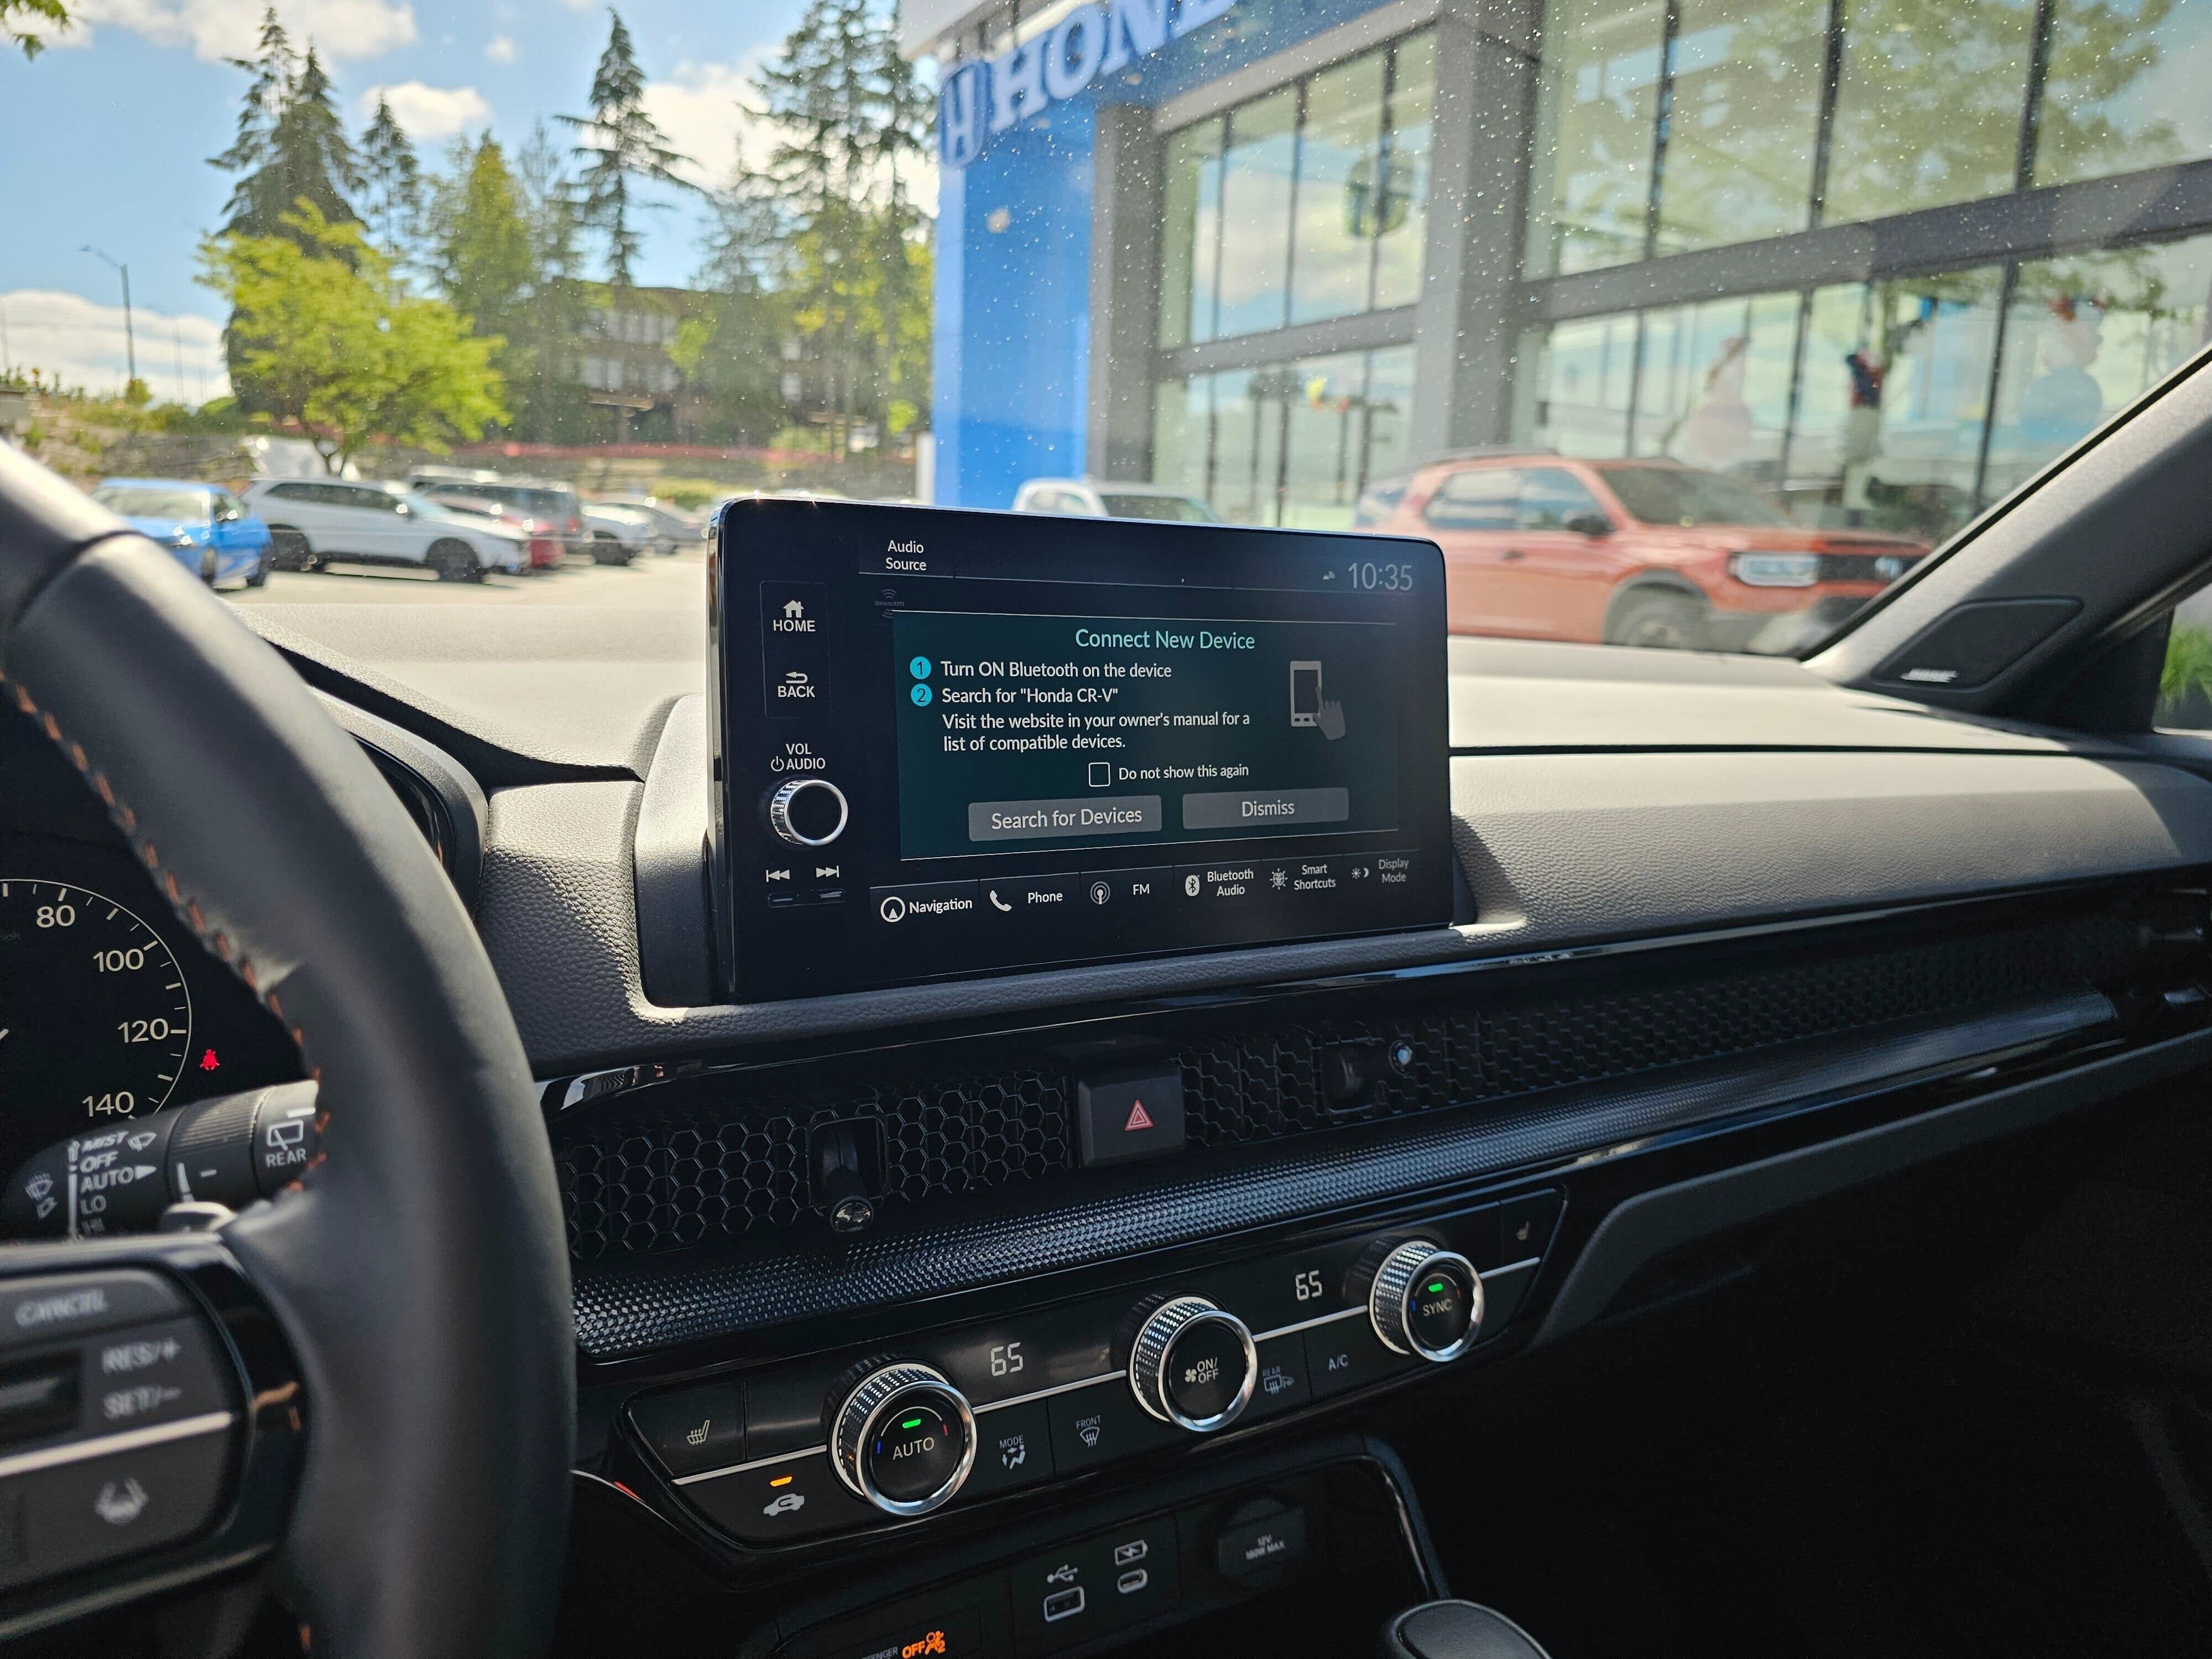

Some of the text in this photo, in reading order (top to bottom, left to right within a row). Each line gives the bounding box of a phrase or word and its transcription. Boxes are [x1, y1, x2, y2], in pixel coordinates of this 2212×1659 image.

[888, 540, 924, 554] Audio
[885, 557, 927, 572] Source
[1348, 562, 1413, 591] 10:35
[773, 619, 816, 633] HOME
[1076, 629, 1255, 649] Connect New Device
[940, 661, 974, 676] Turn
[978, 661, 1004, 677] ON
[1009, 661, 1078, 677] Bluetooth
[1083, 667, 1099, 677] on
[1104, 662, 1125, 677] the
[1129, 662, 1172, 677] device
[777, 685, 816, 698] BACK
[942, 687, 991, 703] Search
[995, 688, 1017, 703] for
[1021, 688, 1073, 703] "Honda
[1077, 688, 1118, 703] CR-V"
[942, 711, 1250, 731] Visit the website in your owner's manual for a
[786, 743, 812, 755] VOL
[944, 733, 1126, 753] list of compatible devices.
[786, 758, 826, 771] AUDIO
[1119, 764, 1249, 780] Do not show this again
[1241, 800, 1295, 817] Dismiss
[992, 807, 1142, 830] Search for Devices
[1301, 864, 1327, 875] Smart
[1378, 859, 1409, 871] Display
[1207, 870, 1254, 882] Bluetooth
[1293, 878, 1336, 890] Shortcuts
[1381, 873, 1406, 883] Mode
[1027, 890, 1063, 905] Phone
[1133, 884, 1150, 896] FM
[1217, 885, 1245, 897] Audio
[909, 897, 973, 915] Navigation
[36, 905, 75, 928] 80
[93, 948, 144, 972] 100
[117, 1018, 169, 1042] 120
[82, 1091, 134, 1117] 140
[82, 1131, 129, 1151] MIST
[80, 1150, 118, 1173] OFF
[266, 1148, 306, 1168] REAR
[80, 1166, 134, 1194] AUTO
[80, 1194, 106, 1214] LO
[1295, 1270, 1323, 1301] 65
[1422, 1298, 1453, 1317] SYNC
[990, 1342, 1024, 1377] 65
[1197, 1357, 1218, 1371] ON/
[1328, 1354, 1349, 1371] A/C
[1198, 1369, 1219, 1384] OFF
[1262, 1366, 1280, 1376] REAR
[1076, 1415, 1101, 1430] FRONT
[892, 1437, 935, 1460] AUTO
[999, 1434, 1024, 1449] MODE
[902, 1641, 925, 1659] OFF
